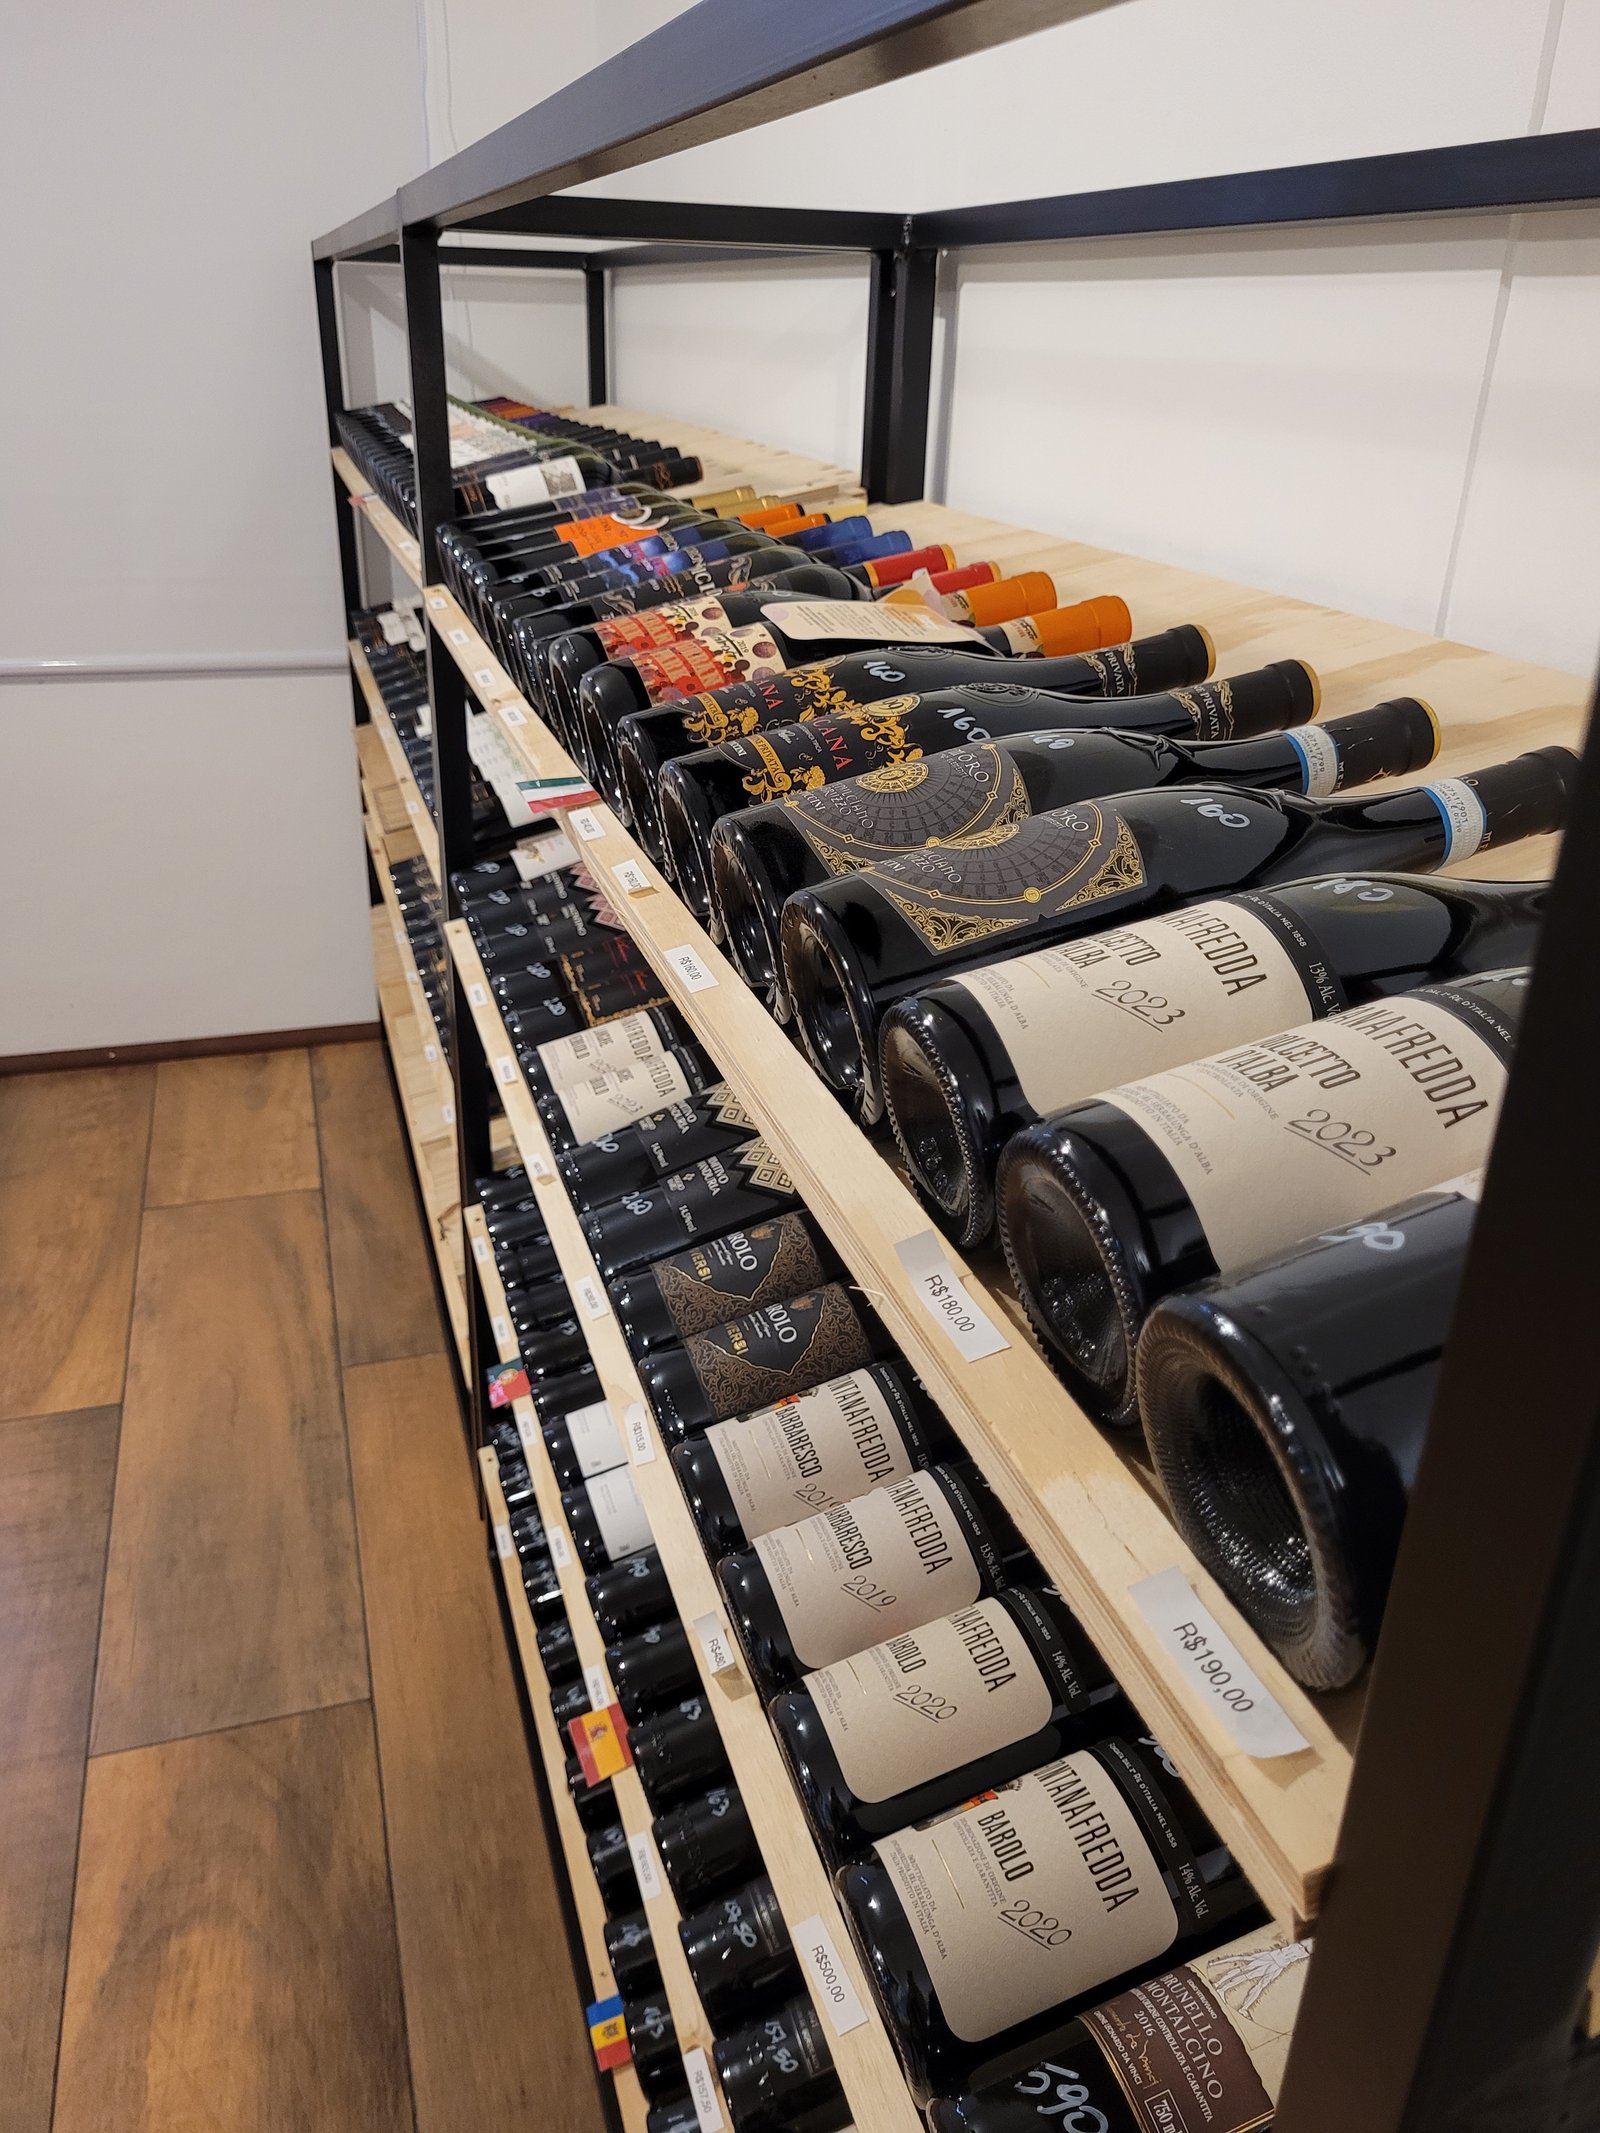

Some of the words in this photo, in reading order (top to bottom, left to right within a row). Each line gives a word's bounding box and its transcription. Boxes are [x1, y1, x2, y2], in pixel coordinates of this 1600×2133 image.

[863, 660, 906, 683] 160
[1106, 652, 1125, 694] PRIVATA
[937, 707, 992, 743] 160
[1200, 692, 1220, 739] PRIVATA
[1280, 917, 1294, 931] NEL
[1291, 930, 1309, 948] 1858
[1309, 961, 1328, 986] 13%
[1094, 979, 1187, 1026] 2023
[1318, 984, 1337, 1005] Alc.
[1494, 1025, 1513, 1043] NEL
[1248, 1086, 1280, 1121] ORIGINE
[1159, 1120, 1184, 1147] ITALIA
[1287, 1107, 1398, 1168] 2023
[1188, 1140, 1215, 1176] D'ALBA
[923, 1274, 976, 1334] R$180,00
[775, 1405, 823, 1479] BARBARESCO
[842, 1574, 897, 1607] 2019
[1171, 1620, 1255, 1715] R$190,00
[895, 1684, 958, 1721] 2020
[977, 1809, 1035, 1883] BAROLO
[1155, 1811, 1167, 1829] NEL
[1164, 1828, 1178, 1849] 1858
[974, 1862, 998, 1908] GARANTITA
[987, 1871, 1007, 1905] ORIGINE
[1178, 1862, 1197, 1886] 14%
[915, 1906, 930, 1936] ITALIA
[928, 1900, 937, 1913] DA
[1000, 1899, 1073, 1946] 2020
[932, 1930, 948, 1961] D'ALBA
[811, 1944, 846, 2004] R$500,00
[1133, 2010, 1157, 2037] 2016
[1159, 1973, 1224, 2056] BRUNELLO
[1103, 2020, 1125, 2052] LEONARDO
[1121, 2050, 1131, 2064] DA
[1126, 2061, 1143, 2086] VINCI
[1147, 1981, 1224, 2100] MONTALCINO
[1154, 2017, 1186, 2070] CONTROLLATA
[1185, 2072, 1214, 2123] GARANTITA
[1152, 2098, 1174, 2126] 750
